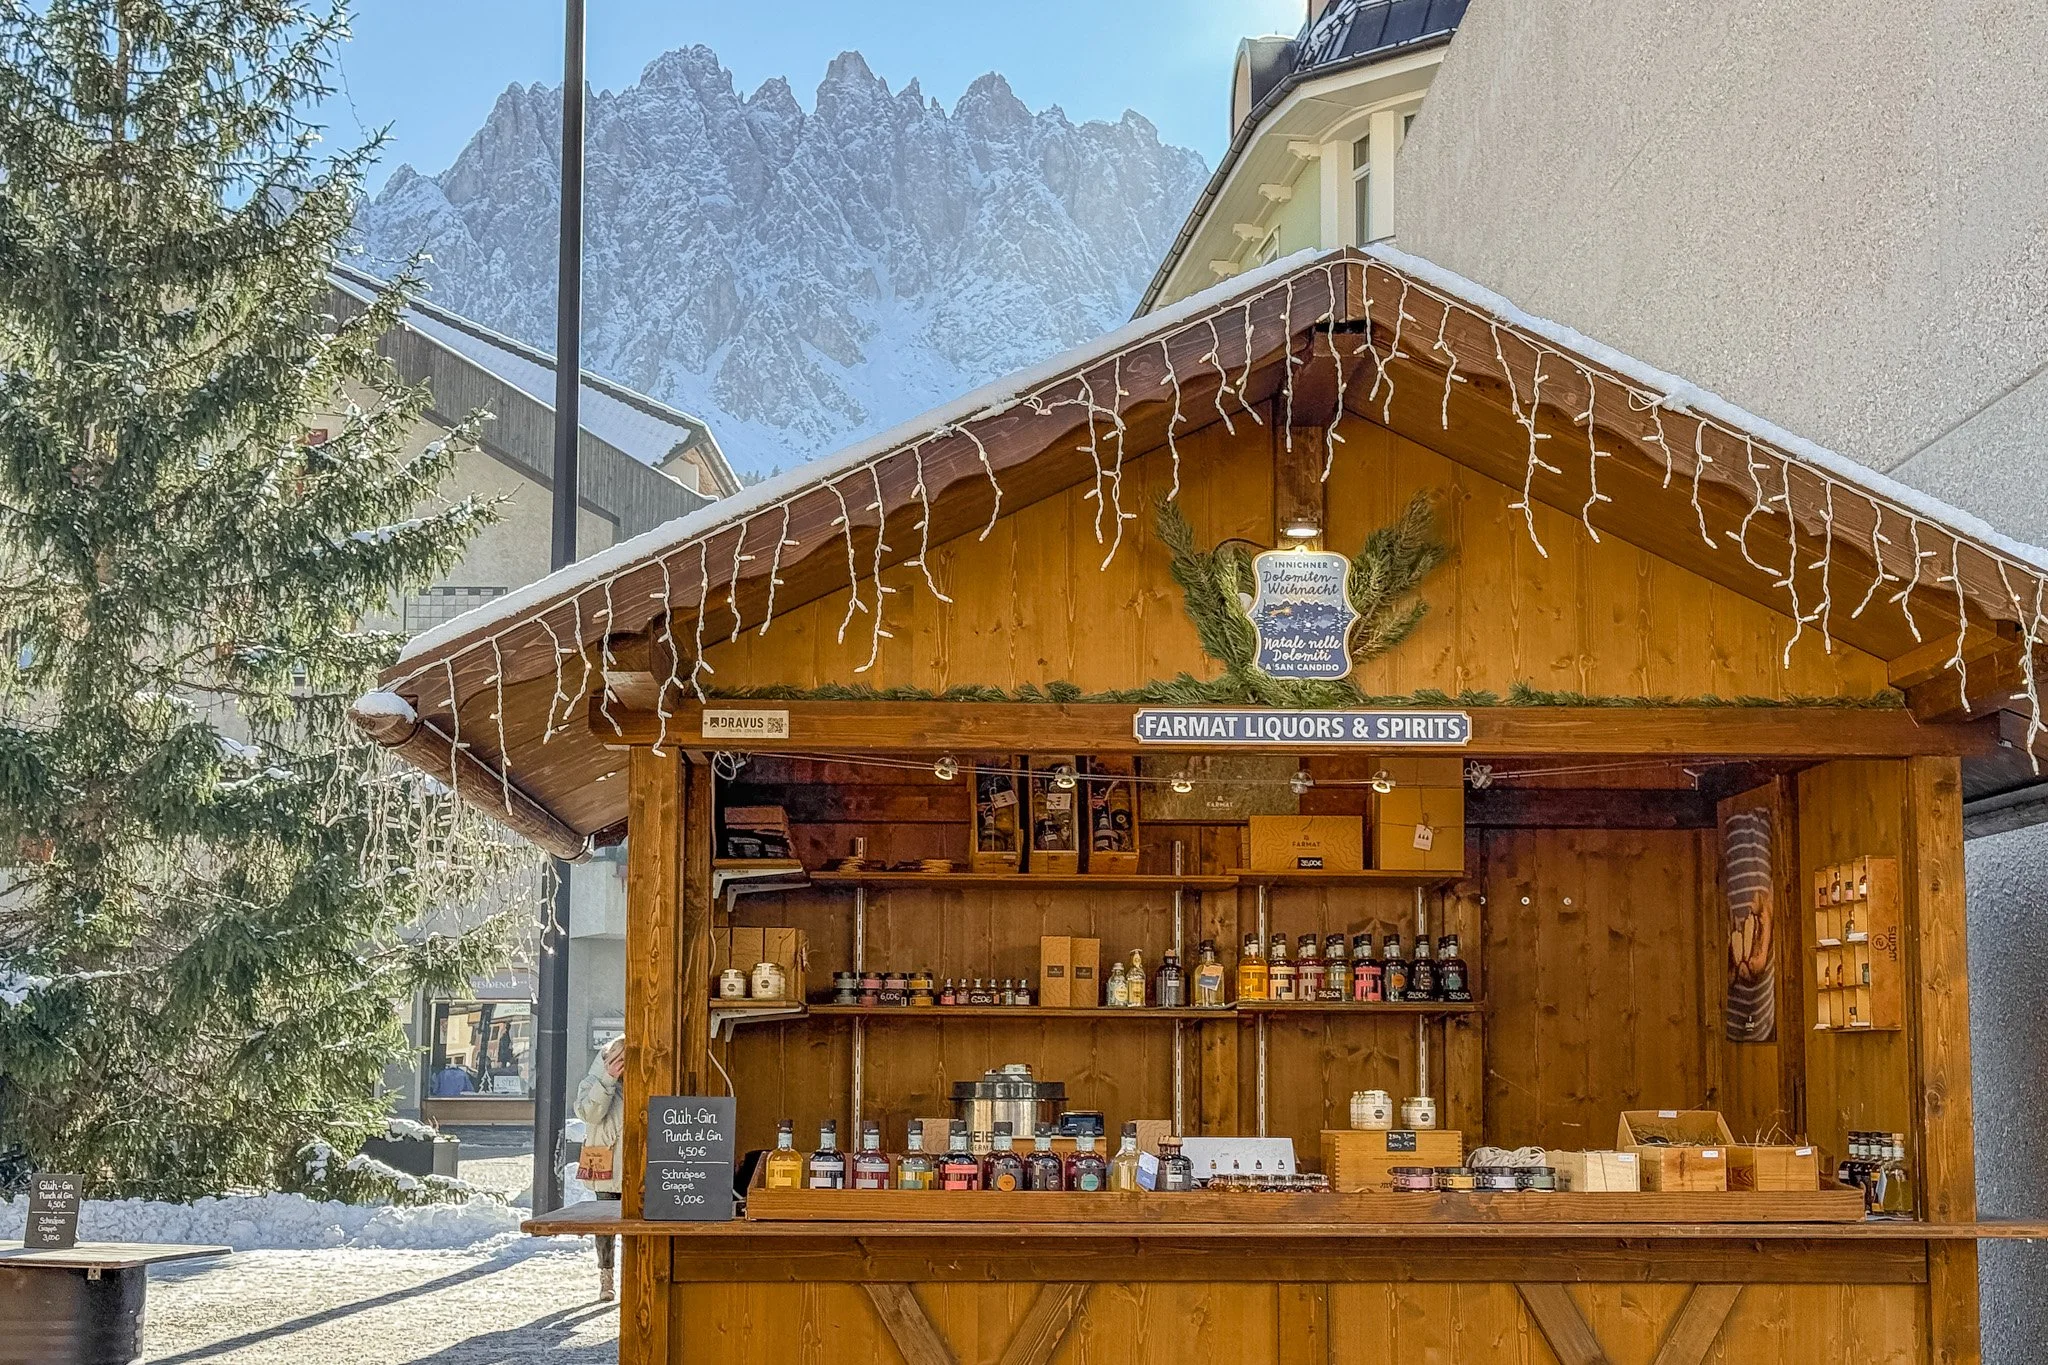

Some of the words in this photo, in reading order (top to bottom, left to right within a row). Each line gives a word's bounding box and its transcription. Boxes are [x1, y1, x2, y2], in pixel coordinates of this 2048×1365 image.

[1274, 560, 1329, 569] INNICHNER
[1263, 570, 1338, 583] Dolomiten-
[1267, 582, 1340, 596] Weihnacht
[1264, 635, 1306, 650] Natale
[1308, 635, 1342, 649] nelle
[1271, 648, 1333, 662] Dolomiti
[1265, 663, 1273, 671] A
[1274, 663, 1295, 671] SAN
[1297, 663, 1340, 671] CANDIDO
[721, 717, 764, 728] DRAVUS
[1145, 716, 1238, 737] FARMAT
[1245, 717, 1344, 740] LIQUORS
[1352, 717, 1369, 738] &
[1376, 717, 1461, 739] SPIRITS
[880, 992, 901, 1002] 6,00€
[662, 1128, 692, 1143] Punch
[694, 1128, 705, 1142] al
[706, 1129, 724, 1142] Gin
[678, 1146, 707, 1160] 4,50€
[661, 1181, 695, 1192] Grappe
[673, 1194, 705, 1206] 3,00€
